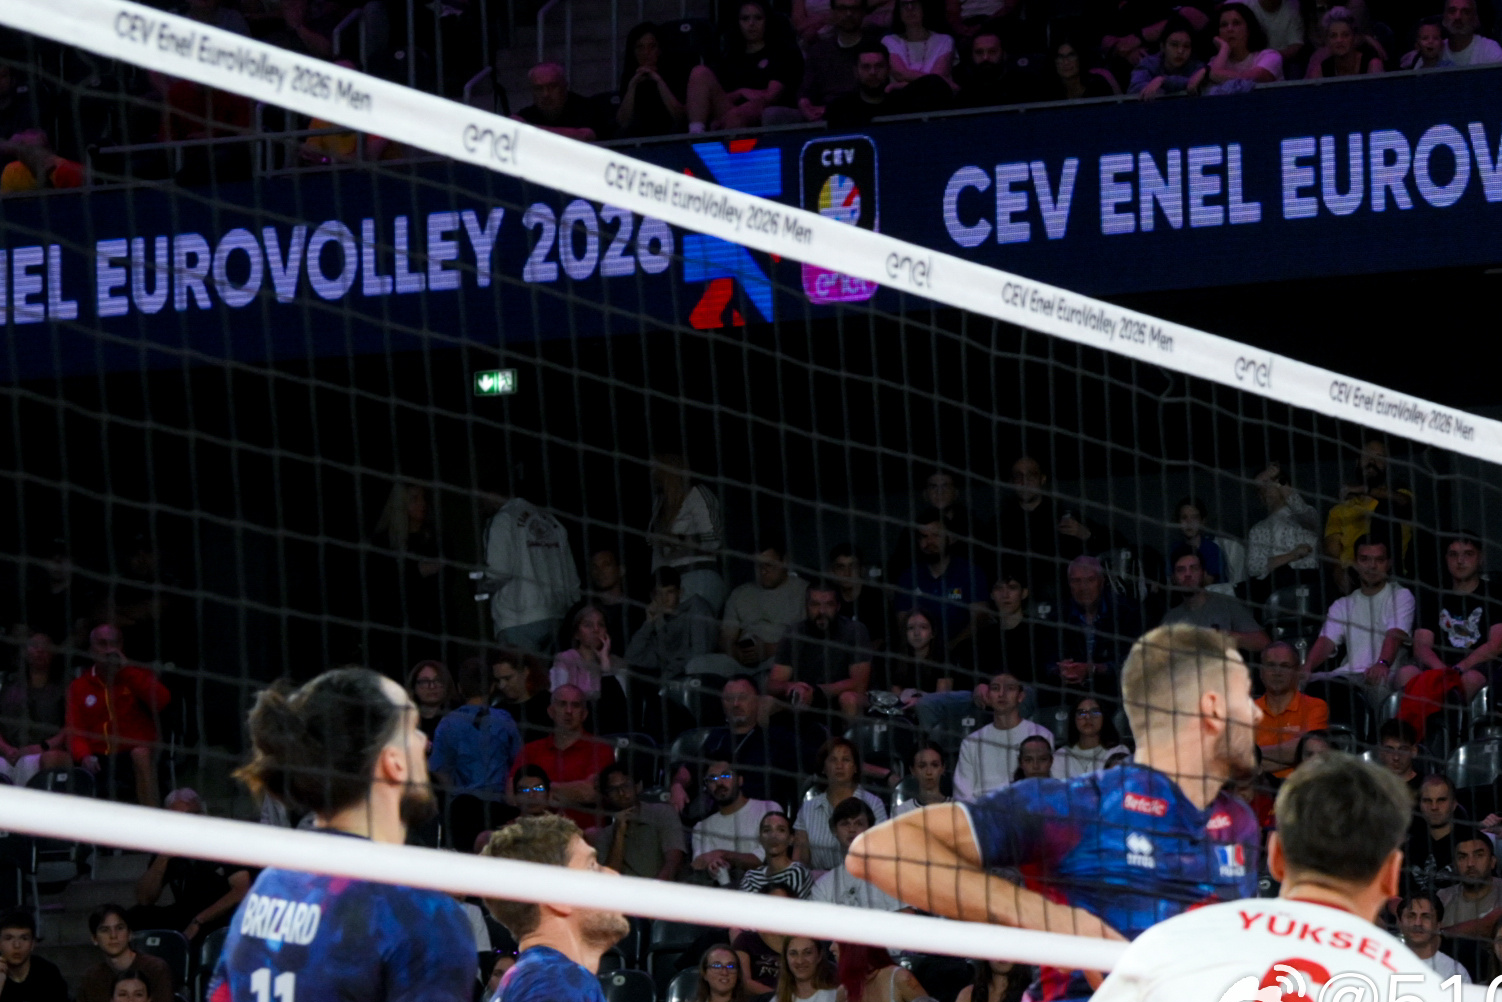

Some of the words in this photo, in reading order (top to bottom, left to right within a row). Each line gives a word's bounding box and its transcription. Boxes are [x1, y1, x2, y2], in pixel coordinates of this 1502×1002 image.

[114, 10, 155, 45] CEV
[157, 23, 195, 58] Enel
[198, 35, 288, 92] EuroVolley
[335, 79, 373, 112] Men
[463, 121, 520, 165] enel
[821, 147, 856, 167] CEV
[604, 161, 636, 194] CEV
[638, 172, 668, 203] Enel
[670, 181, 744, 232] EuroVolley
[746, 204, 779, 236] 2026
[782, 216, 814, 244] Men
[943, 156, 1079, 247] CEV
[1099, 142, 1262, 235] ENEL
[96, 207, 504, 318] EUROVOLLEY
[522, 199, 676, 282] 2026
[885, 251, 934, 290] enel
[1001, 280, 1028, 307] CEV
[1030, 289, 1055, 317] Enel
[1056, 297, 1118, 342] EuroVolley
[1149, 325, 1175, 352] Men
[1234, 355, 1273, 390] enel
[1329, 379, 1351, 405] CEV
[1376, 393, 1427, 432] EuroVolley
[1454, 417, 1475, 442] Men
[240, 893, 321, 946] BRIZARD
[1238, 909, 1399, 973] YÜKSEL
